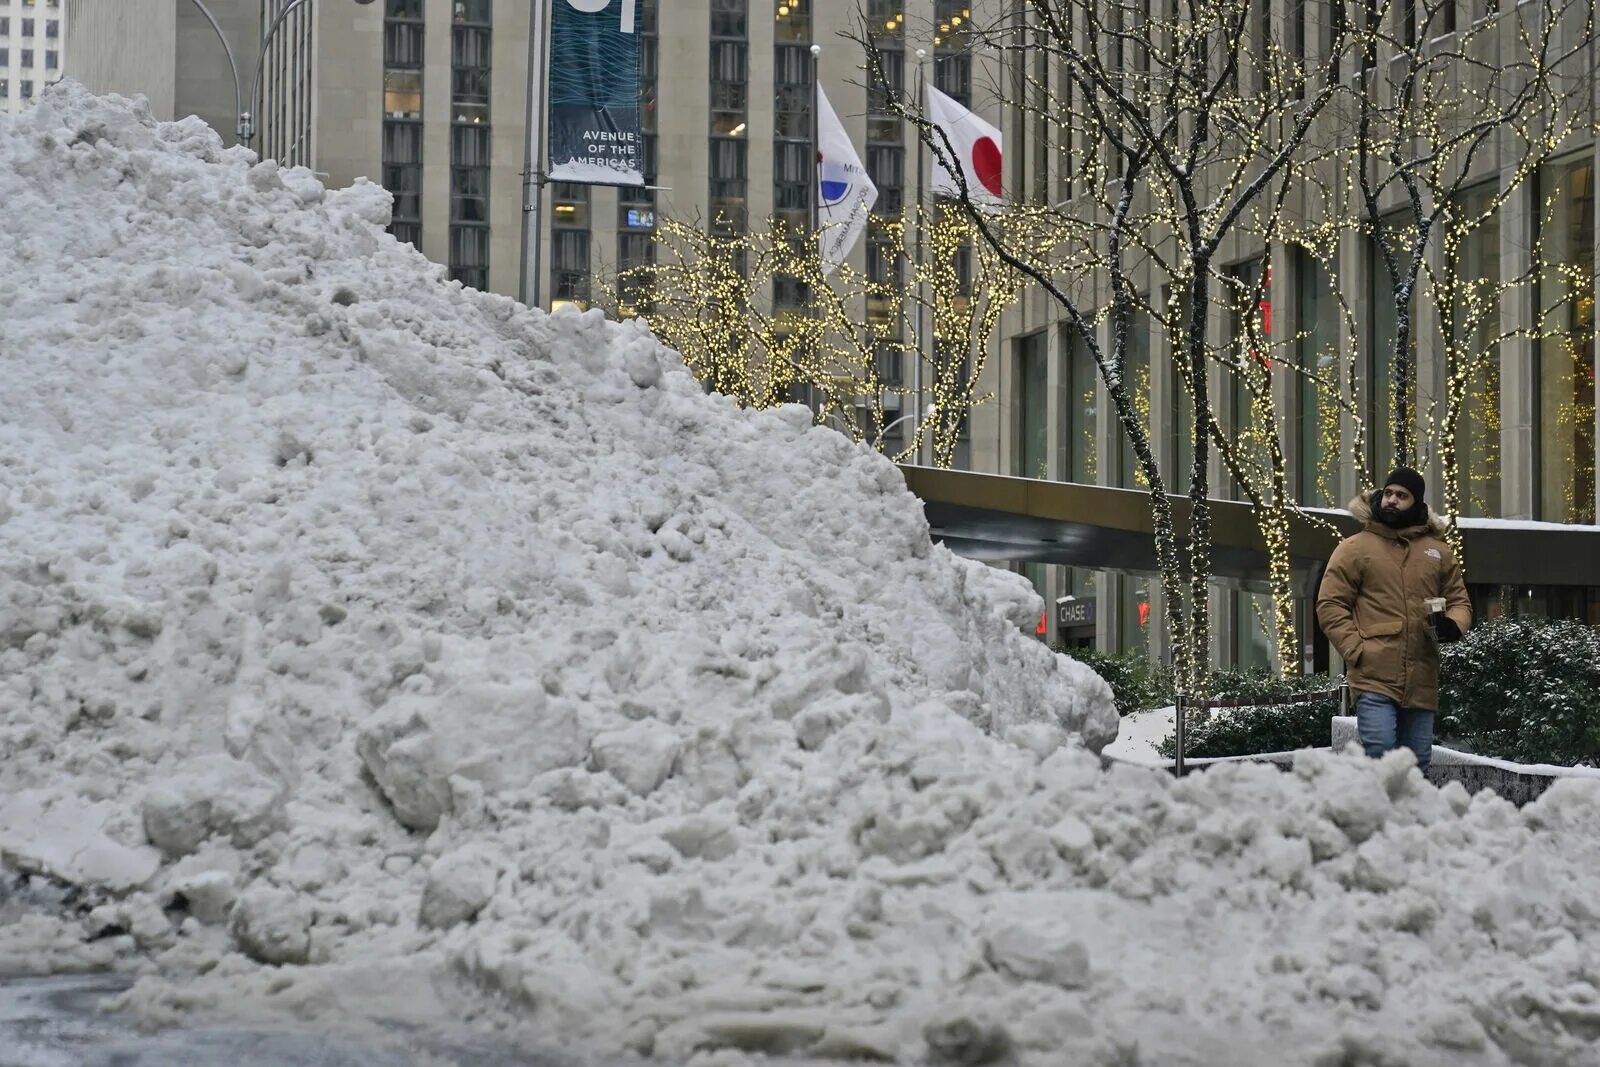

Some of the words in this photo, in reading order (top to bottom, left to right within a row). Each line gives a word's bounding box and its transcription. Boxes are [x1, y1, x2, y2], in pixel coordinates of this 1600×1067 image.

[583, 130, 635, 142] AVENUE
[588, 144, 606, 154] OF
[610, 145, 635, 155] THE
[567, 156, 636, 169] AMERICAS
[1060, 604, 1085, 622] CHASE
